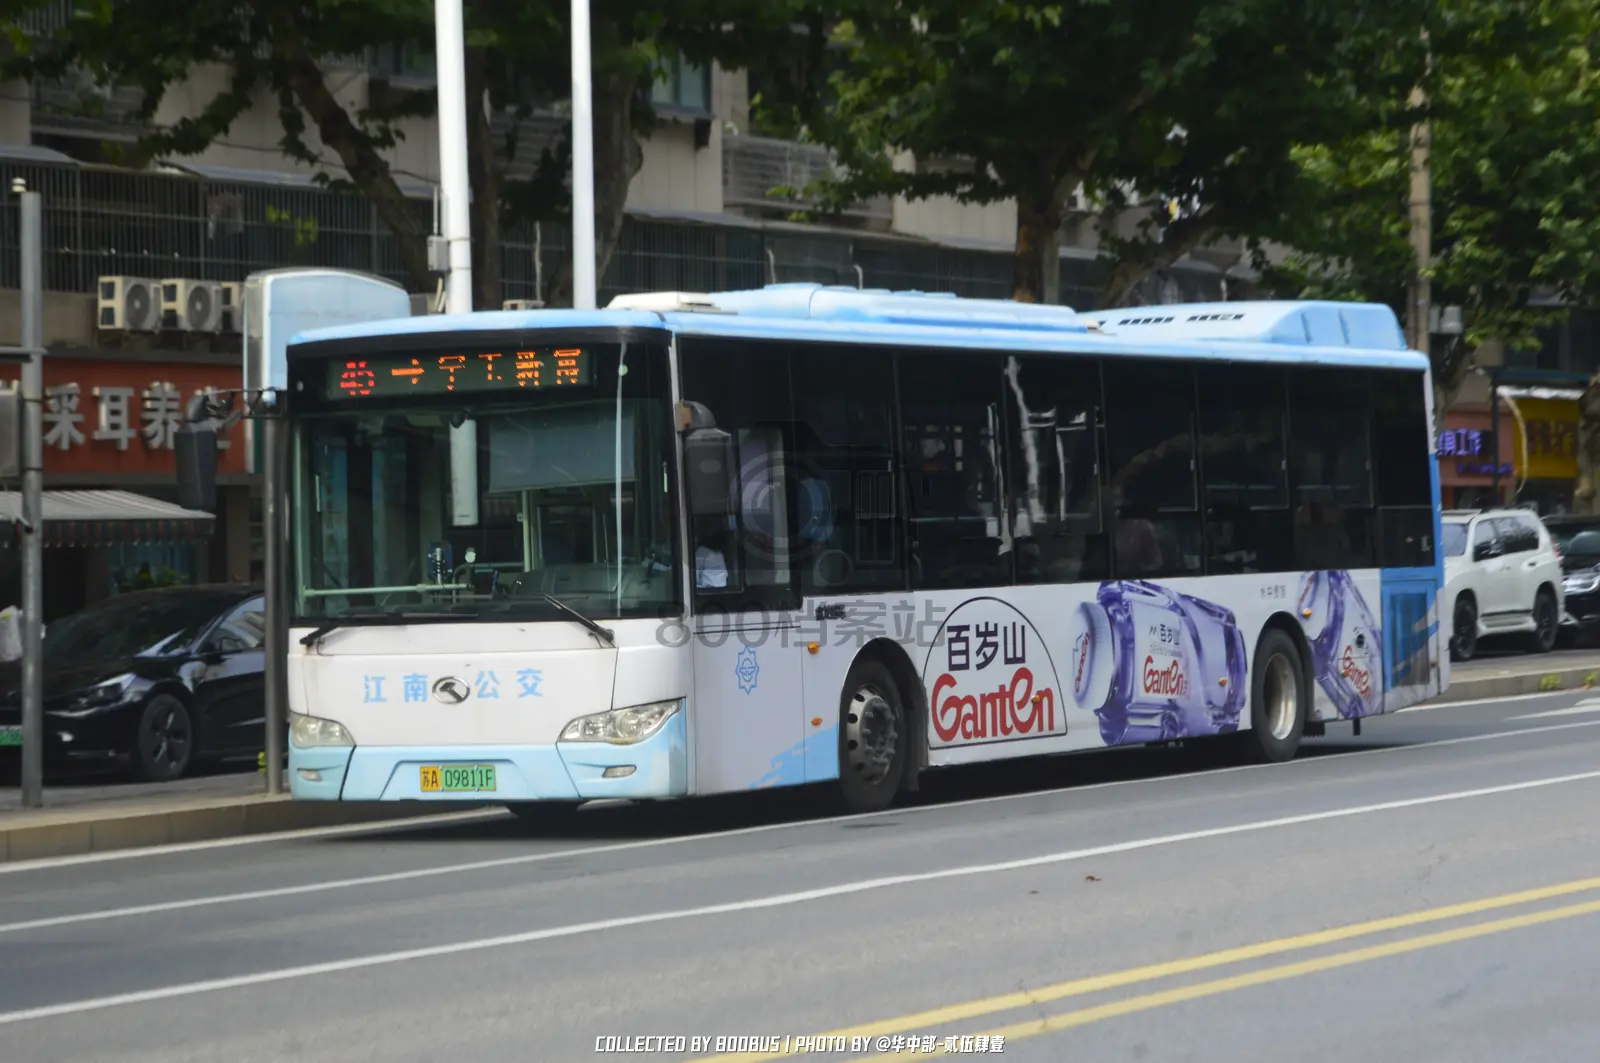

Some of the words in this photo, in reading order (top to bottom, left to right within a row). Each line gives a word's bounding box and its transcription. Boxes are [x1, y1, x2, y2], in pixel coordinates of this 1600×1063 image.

[947, 621, 1026, 671] 百岁山
[364, 668, 544, 704] 江南公交
[931, 666, 1055, 742] Ganten
